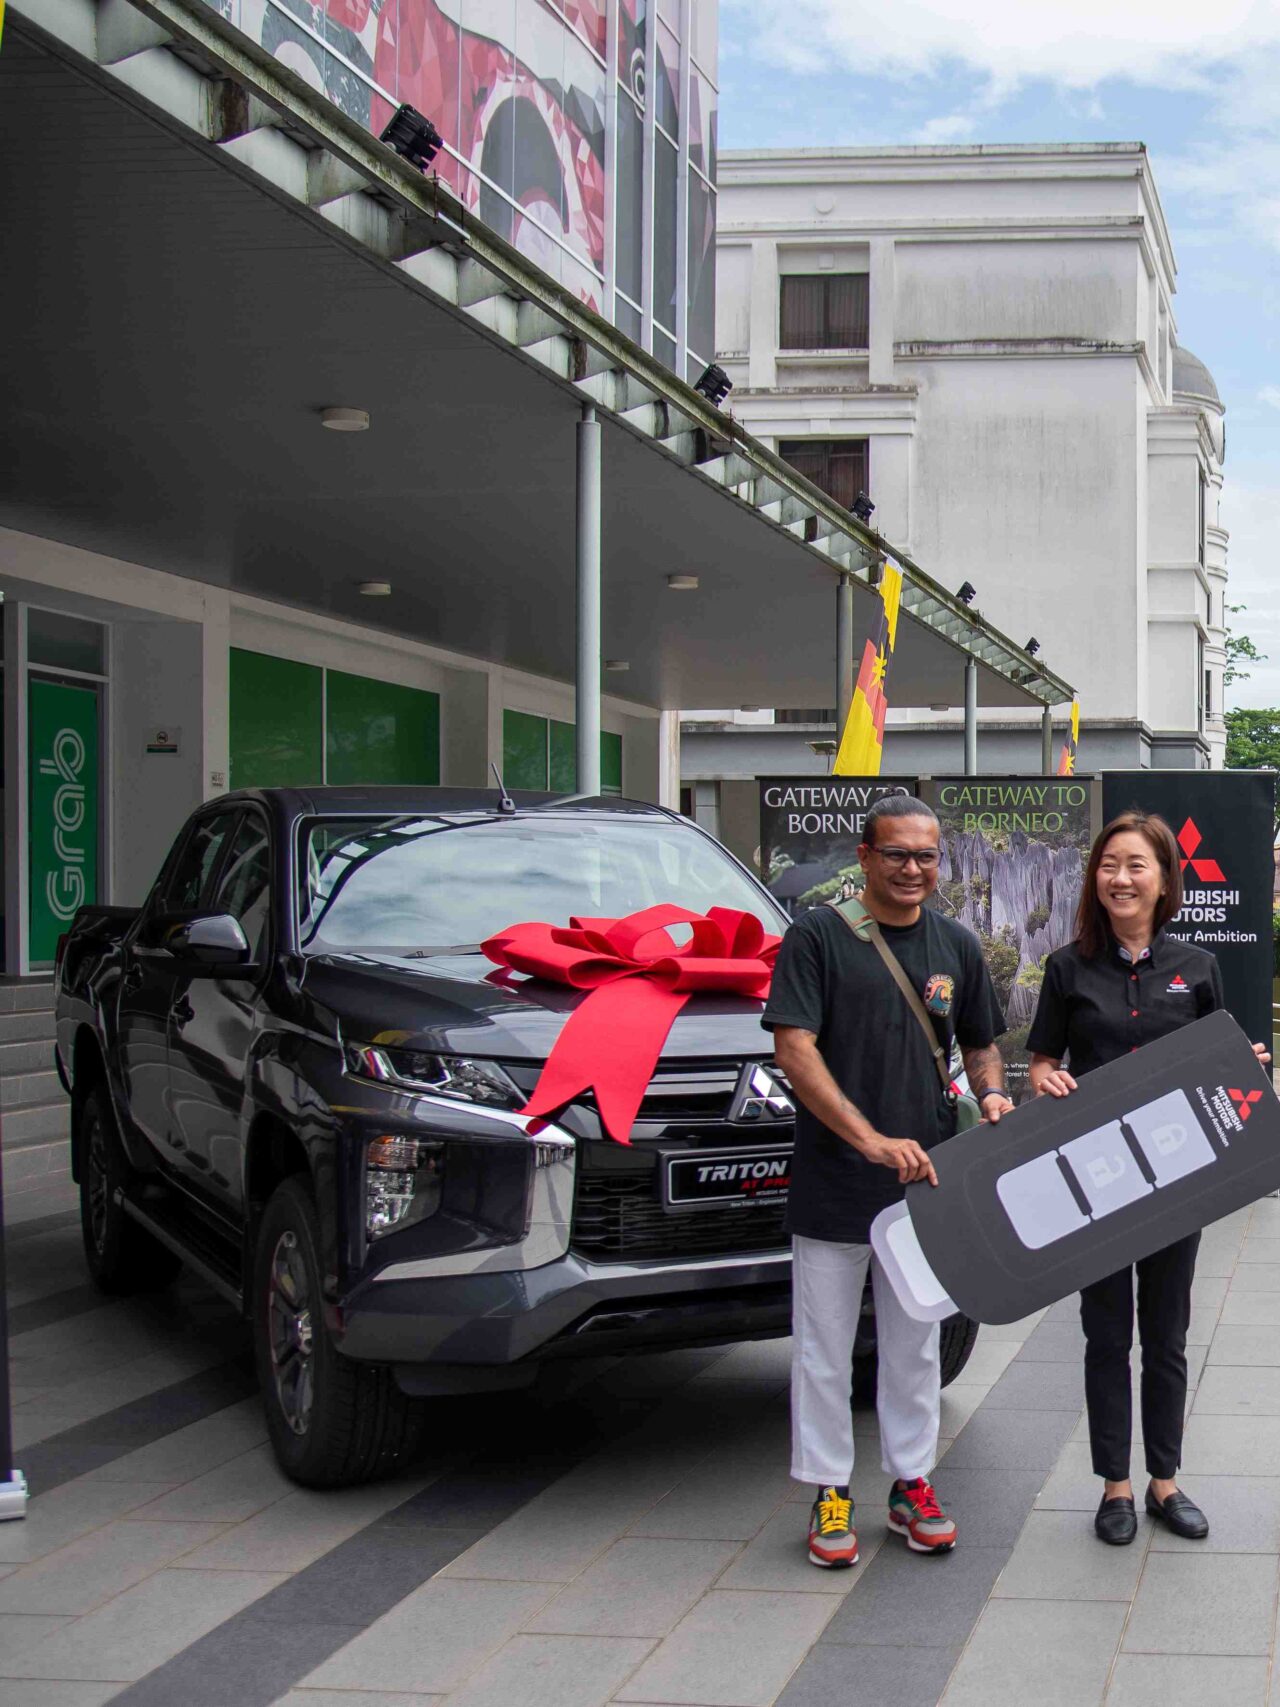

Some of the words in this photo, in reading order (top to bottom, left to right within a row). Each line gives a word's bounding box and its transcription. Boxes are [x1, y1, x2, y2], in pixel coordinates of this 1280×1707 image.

[764, 787, 872, 808] GATEWAY
[940, 786, 1048, 806] GATEWAY
[1052, 785, 1086, 807] TO
[40, 728, 85, 921] Grab
[788, 813, 867, 834] BORNE
[1183, 890, 1240, 905] UBISHI
[1171, 907, 1227, 922] OTORS
[1167, 932, 1192, 942] our
[1194, 930, 1257, 942] Ambition
[1195, 1086, 1206, 1105] Drive
[1203, 1103, 1215, 1119] your
[1211, 1117, 1230, 1147] Ambition
[1210, 1095, 1234, 1130] MOTORS
[1215, 1085, 1244, 1132] MITSUBISHI
[697, 1160, 788, 1183] TRITON
